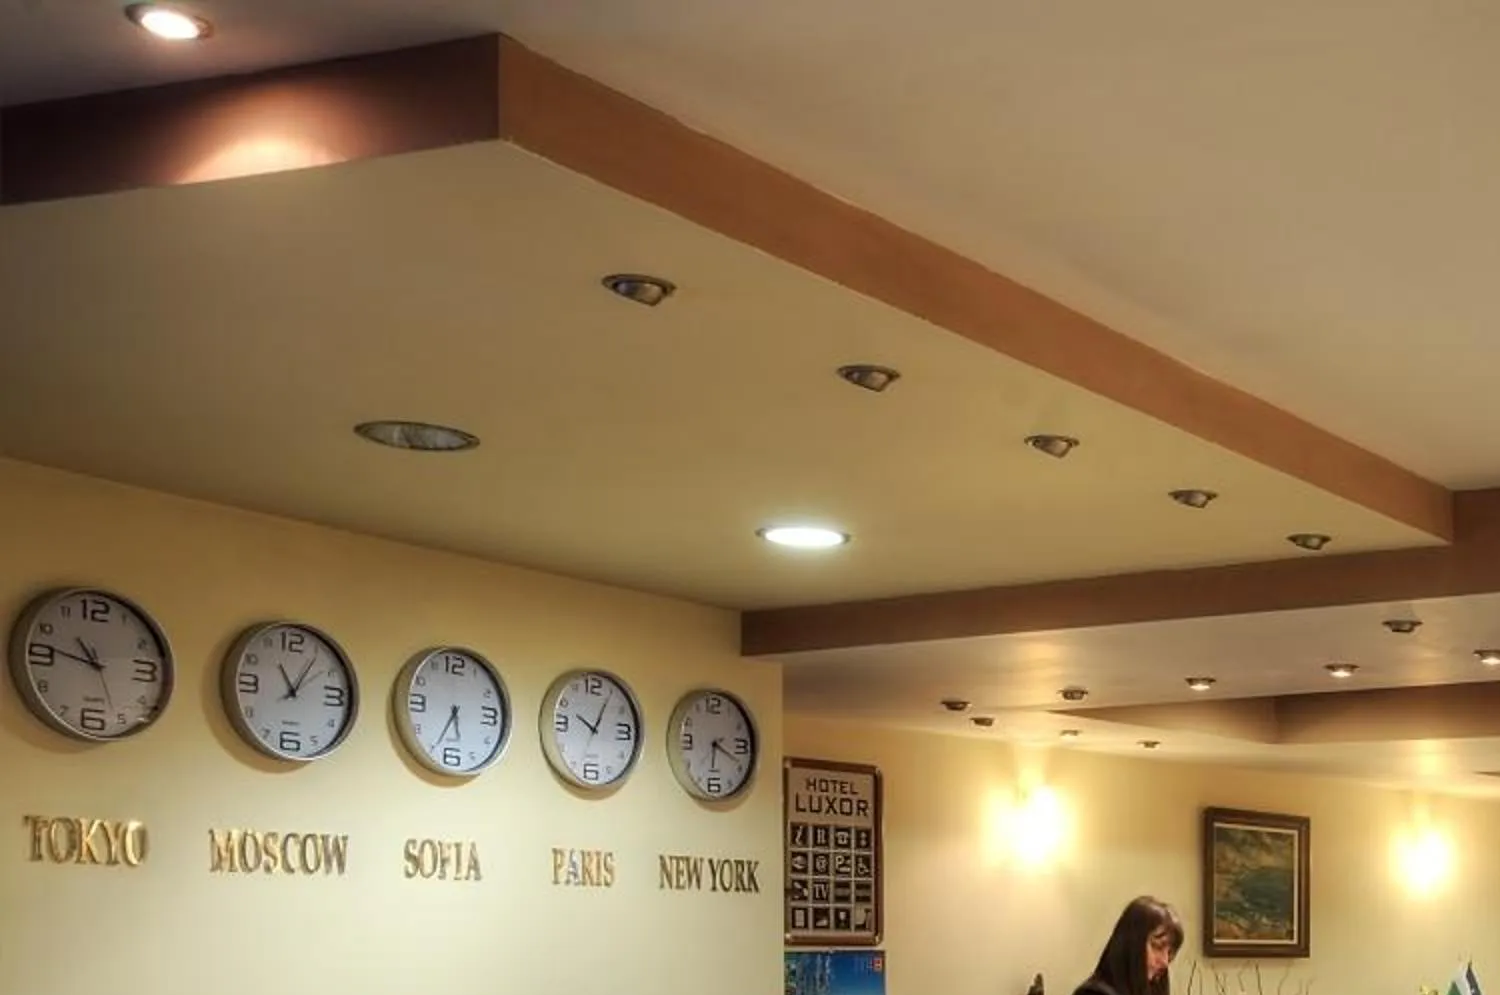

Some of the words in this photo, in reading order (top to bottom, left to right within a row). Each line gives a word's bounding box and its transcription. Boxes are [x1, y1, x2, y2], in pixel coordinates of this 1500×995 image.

[81, 598, 110, 622] 12
[281, 631, 305, 652] 12
[29, 643, 54, 666] 9
[132, 659, 158, 682] 3
[445, 655, 465, 676] 12
[324, 685, 345, 707] 3
[585, 677, 603, 697] 12
[480, 705, 498, 727] 3
[705, 696, 721, 715] 12
[81, 708, 105, 730] 6
[117, 713, 127, 725] 5
[280, 731, 301, 751] 6
[616, 723, 632, 741] 3
[443, 747, 461, 767] 6
[734, 738, 749, 755] 3
[583, 763, 599, 781] 6
[707, 778, 721, 793] 6
[806, 777, 859, 796] HOTEL
[795, 791, 869, 817] LUXOR
[25, 815, 148, 869] TOKYO
[209, 828, 349, 876] MOSCOW
[403, 838, 482, 882] SOFIA
[552, 848, 615, 888] PARIS
[659, 854, 703, 891] NEW
[708, 857, 760, 895] YORK
